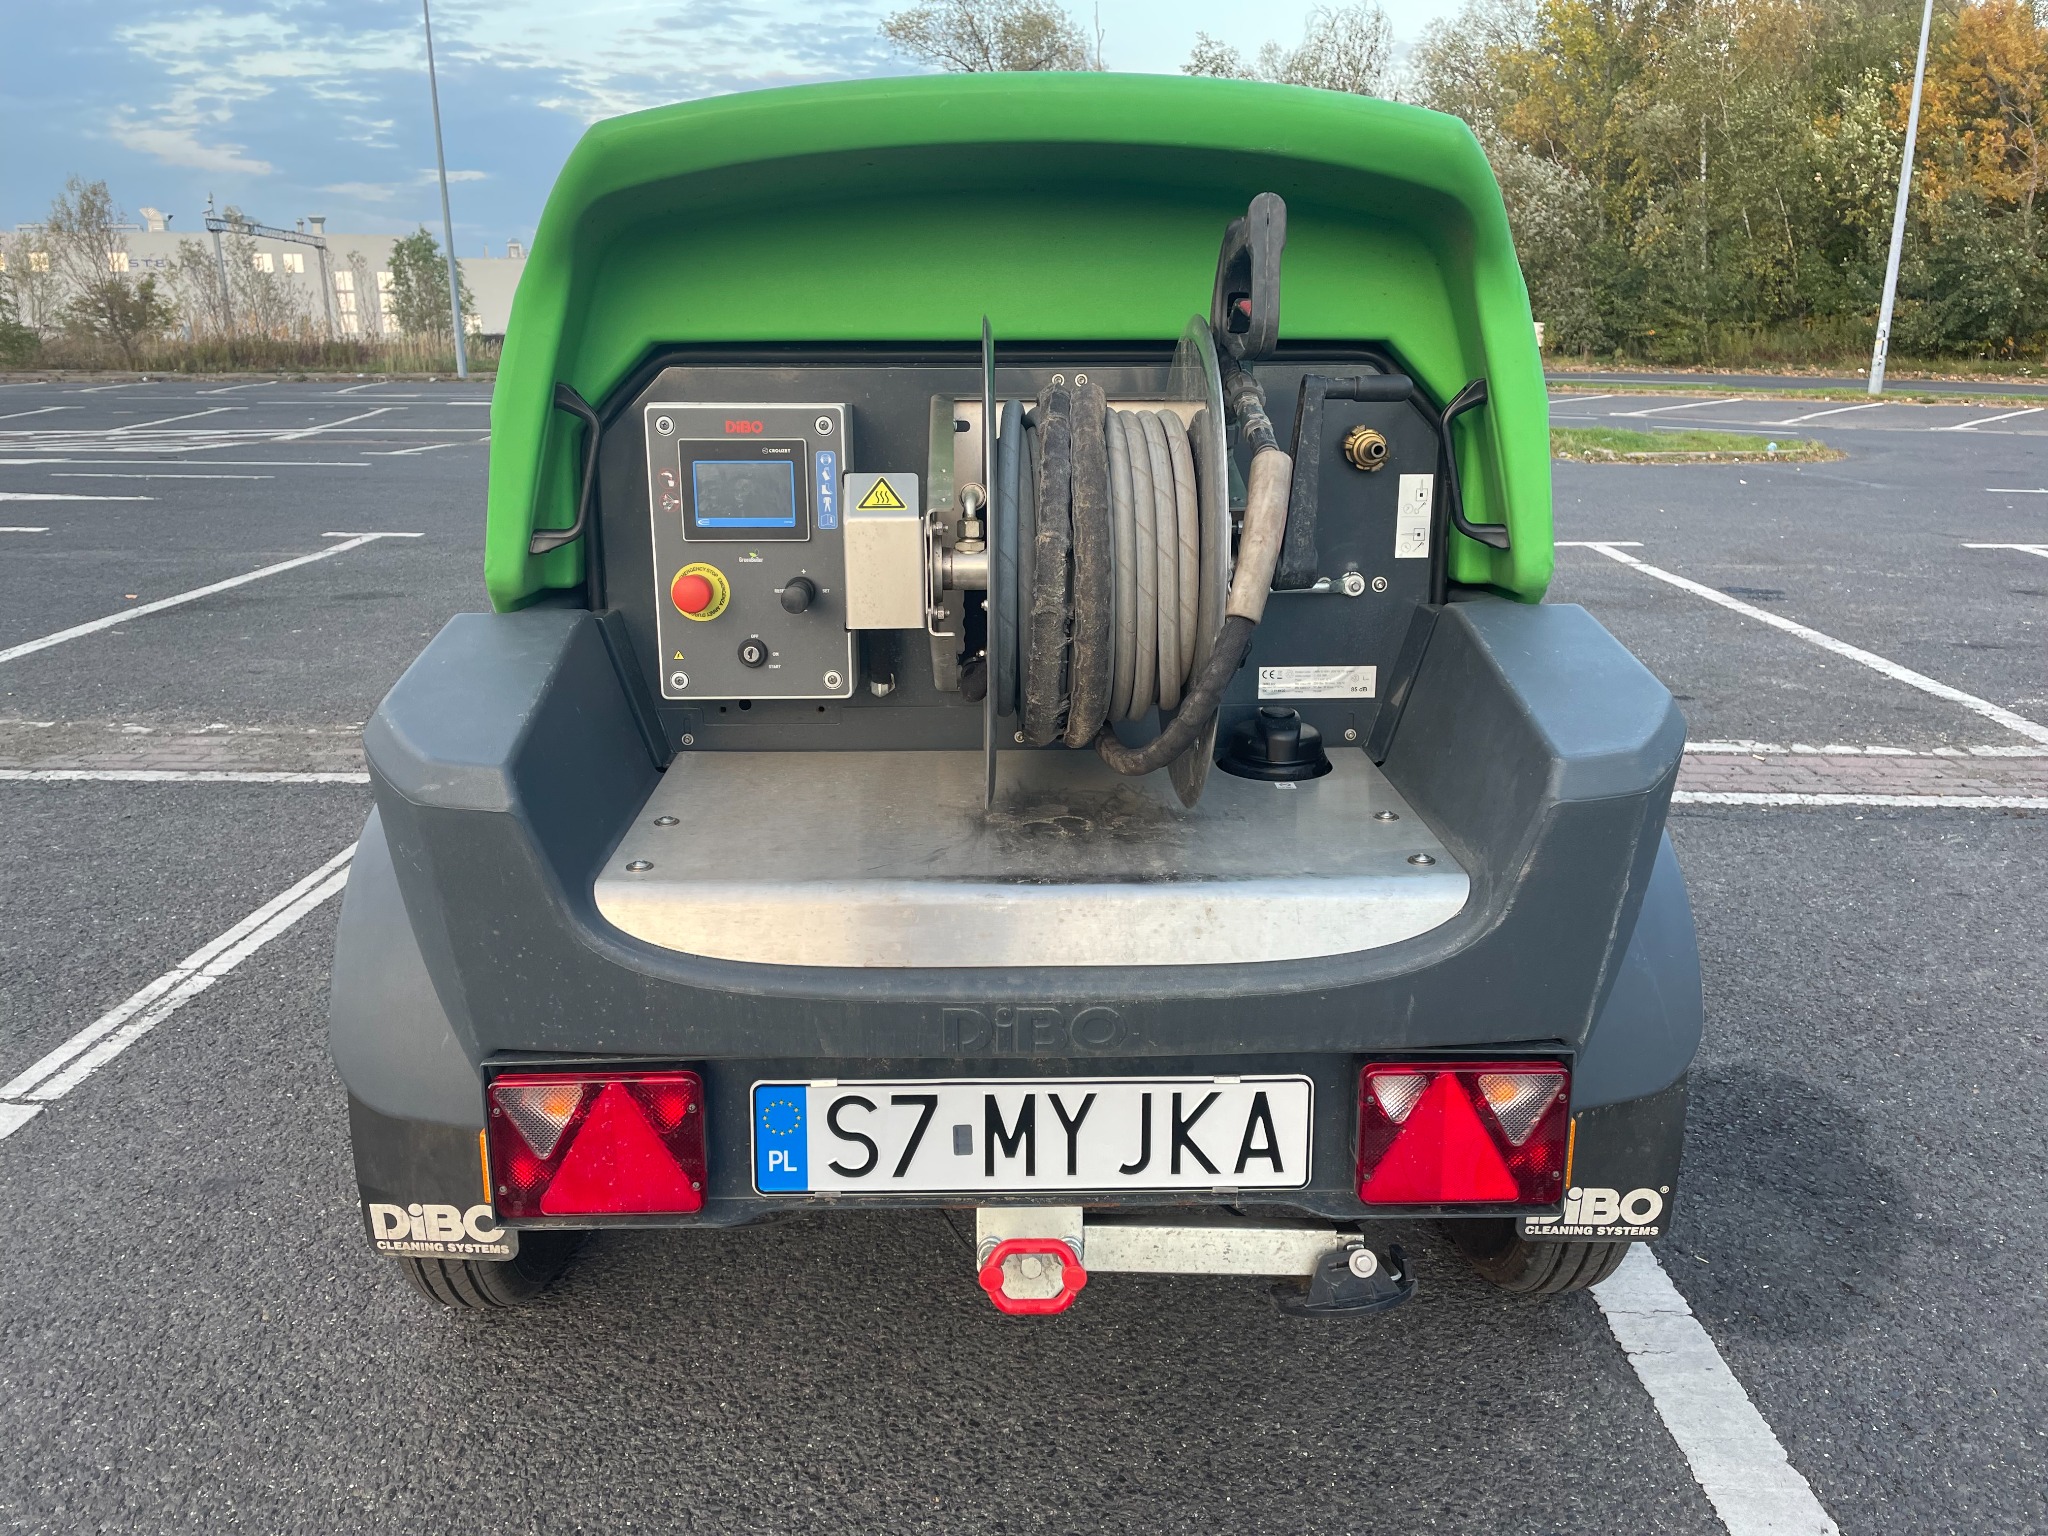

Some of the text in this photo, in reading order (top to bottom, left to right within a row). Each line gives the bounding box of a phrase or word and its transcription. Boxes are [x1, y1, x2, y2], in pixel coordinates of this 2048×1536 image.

[725, 420, 763, 433] DiBO
[941, 1005, 1129, 1053] DiBO
[825, 1093, 939, 1178] S7
[768, 1151, 797, 1172] PL
[1525, 1187, 1663, 1226] iBO
[1525, 1225, 1659, 1236] CLEANING SYSTEMS
[376, 1241, 510, 1254] CLEANING SYSTEMS
